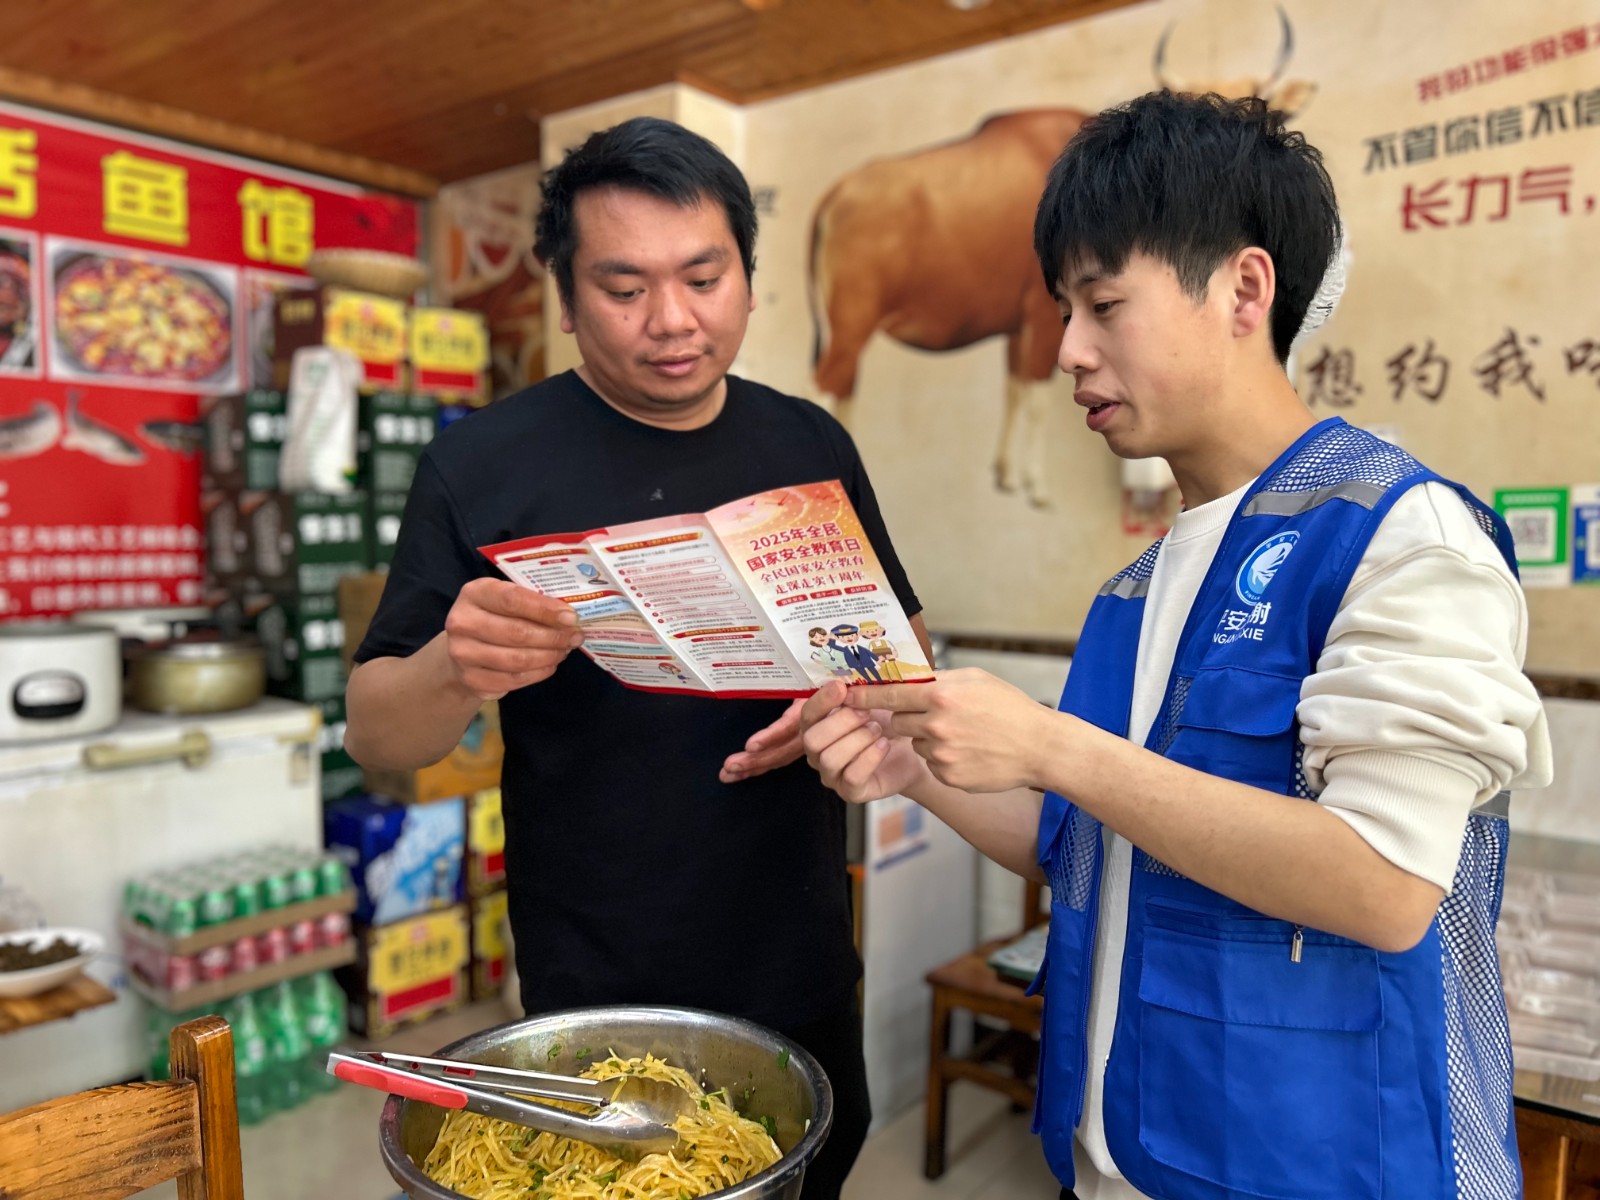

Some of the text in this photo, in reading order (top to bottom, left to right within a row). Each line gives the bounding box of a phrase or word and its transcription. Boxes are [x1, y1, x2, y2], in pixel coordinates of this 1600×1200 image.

[750, 522, 841, 551] 2025年全民
[747, 538, 861, 571] 国家安全教育日
[761, 555, 864, 583] 全民国家安全教育
[775, 570, 865, 594] 走深走实十周年
